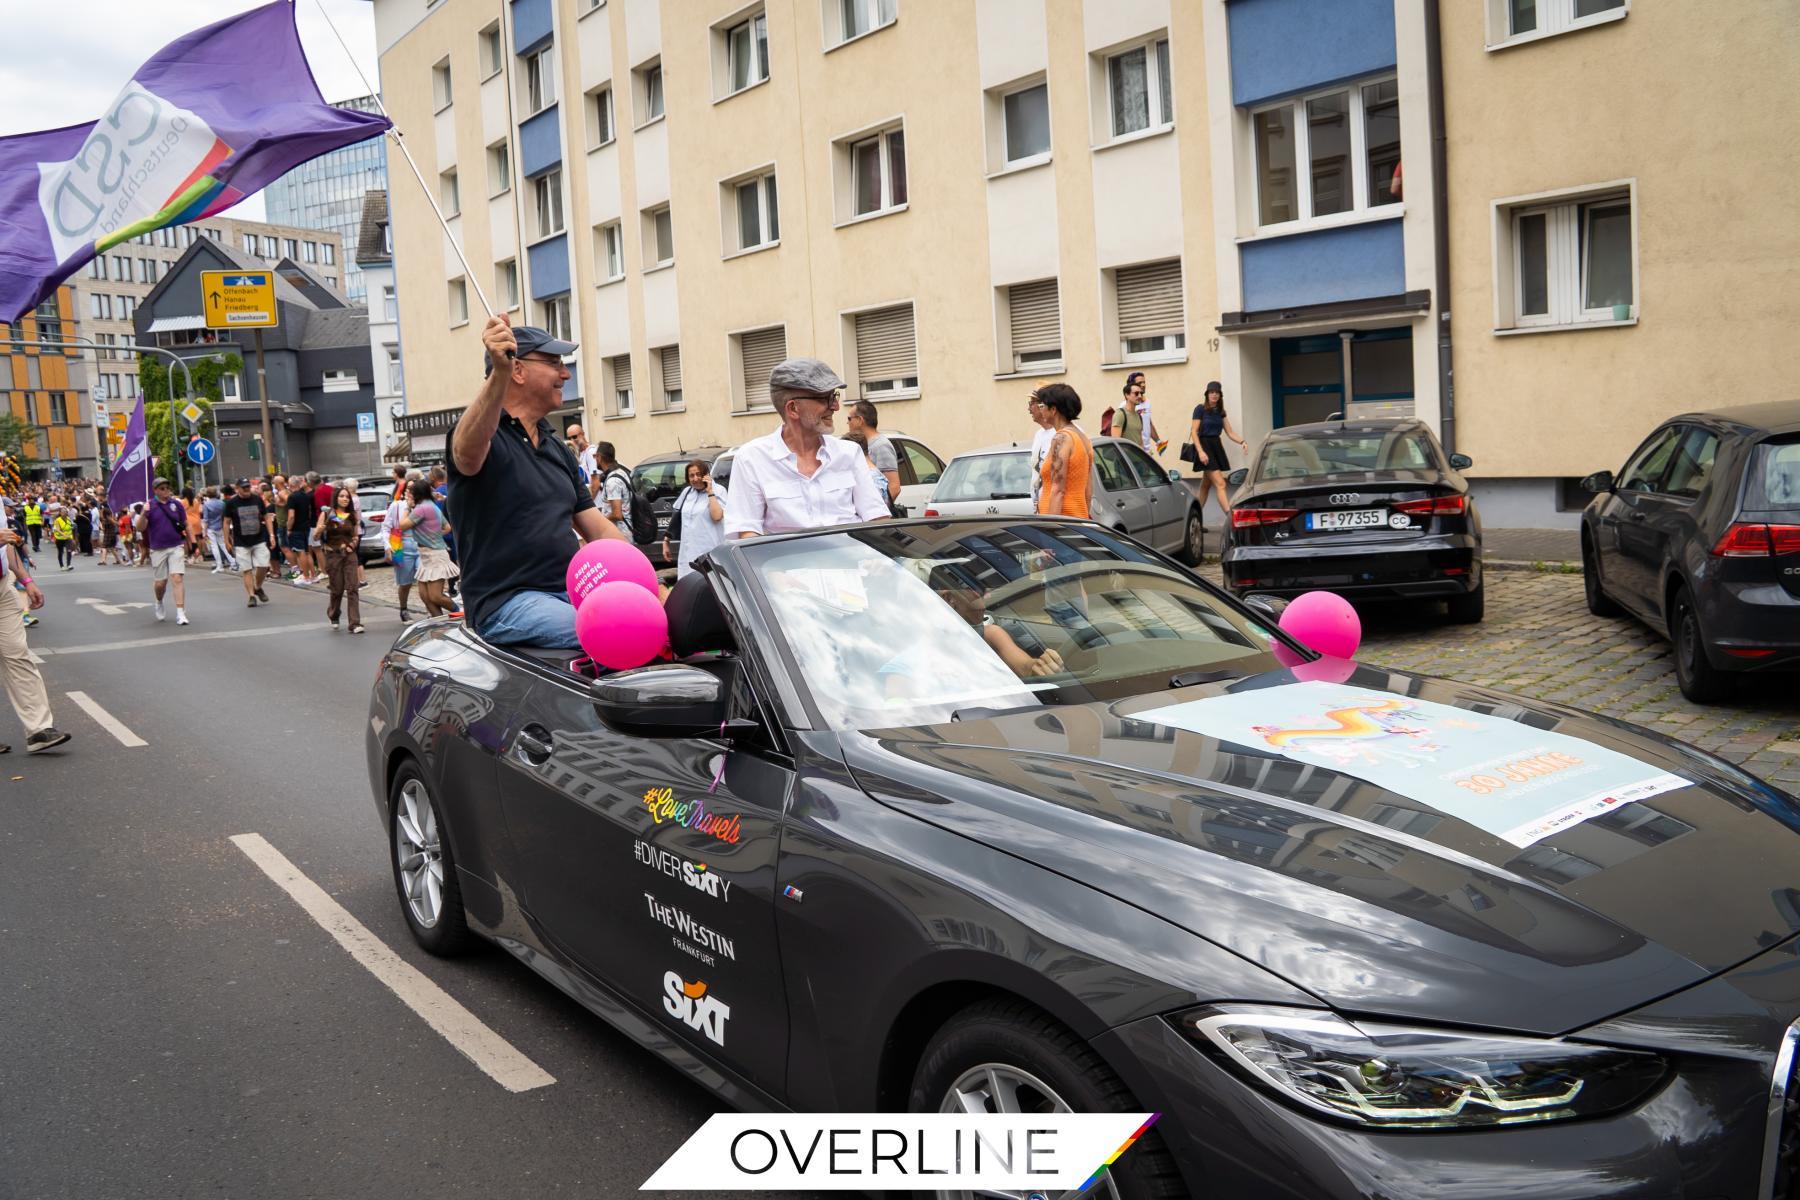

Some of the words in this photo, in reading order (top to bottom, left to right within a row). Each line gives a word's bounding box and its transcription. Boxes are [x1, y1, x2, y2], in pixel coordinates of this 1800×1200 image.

[225, 304, 259, 312] Friedberg
[1207, 338, 1220, 352] 19
[1320, 513, 1329, 527] F
[1337, 511, 1380, 526] 97355
[1392, 516, 1408, 526] CC
[592, 568, 608, 584] und
[643, 787, 741, 844] #LoveTravels
[672, 937, 715, 967] FRANKFURT
